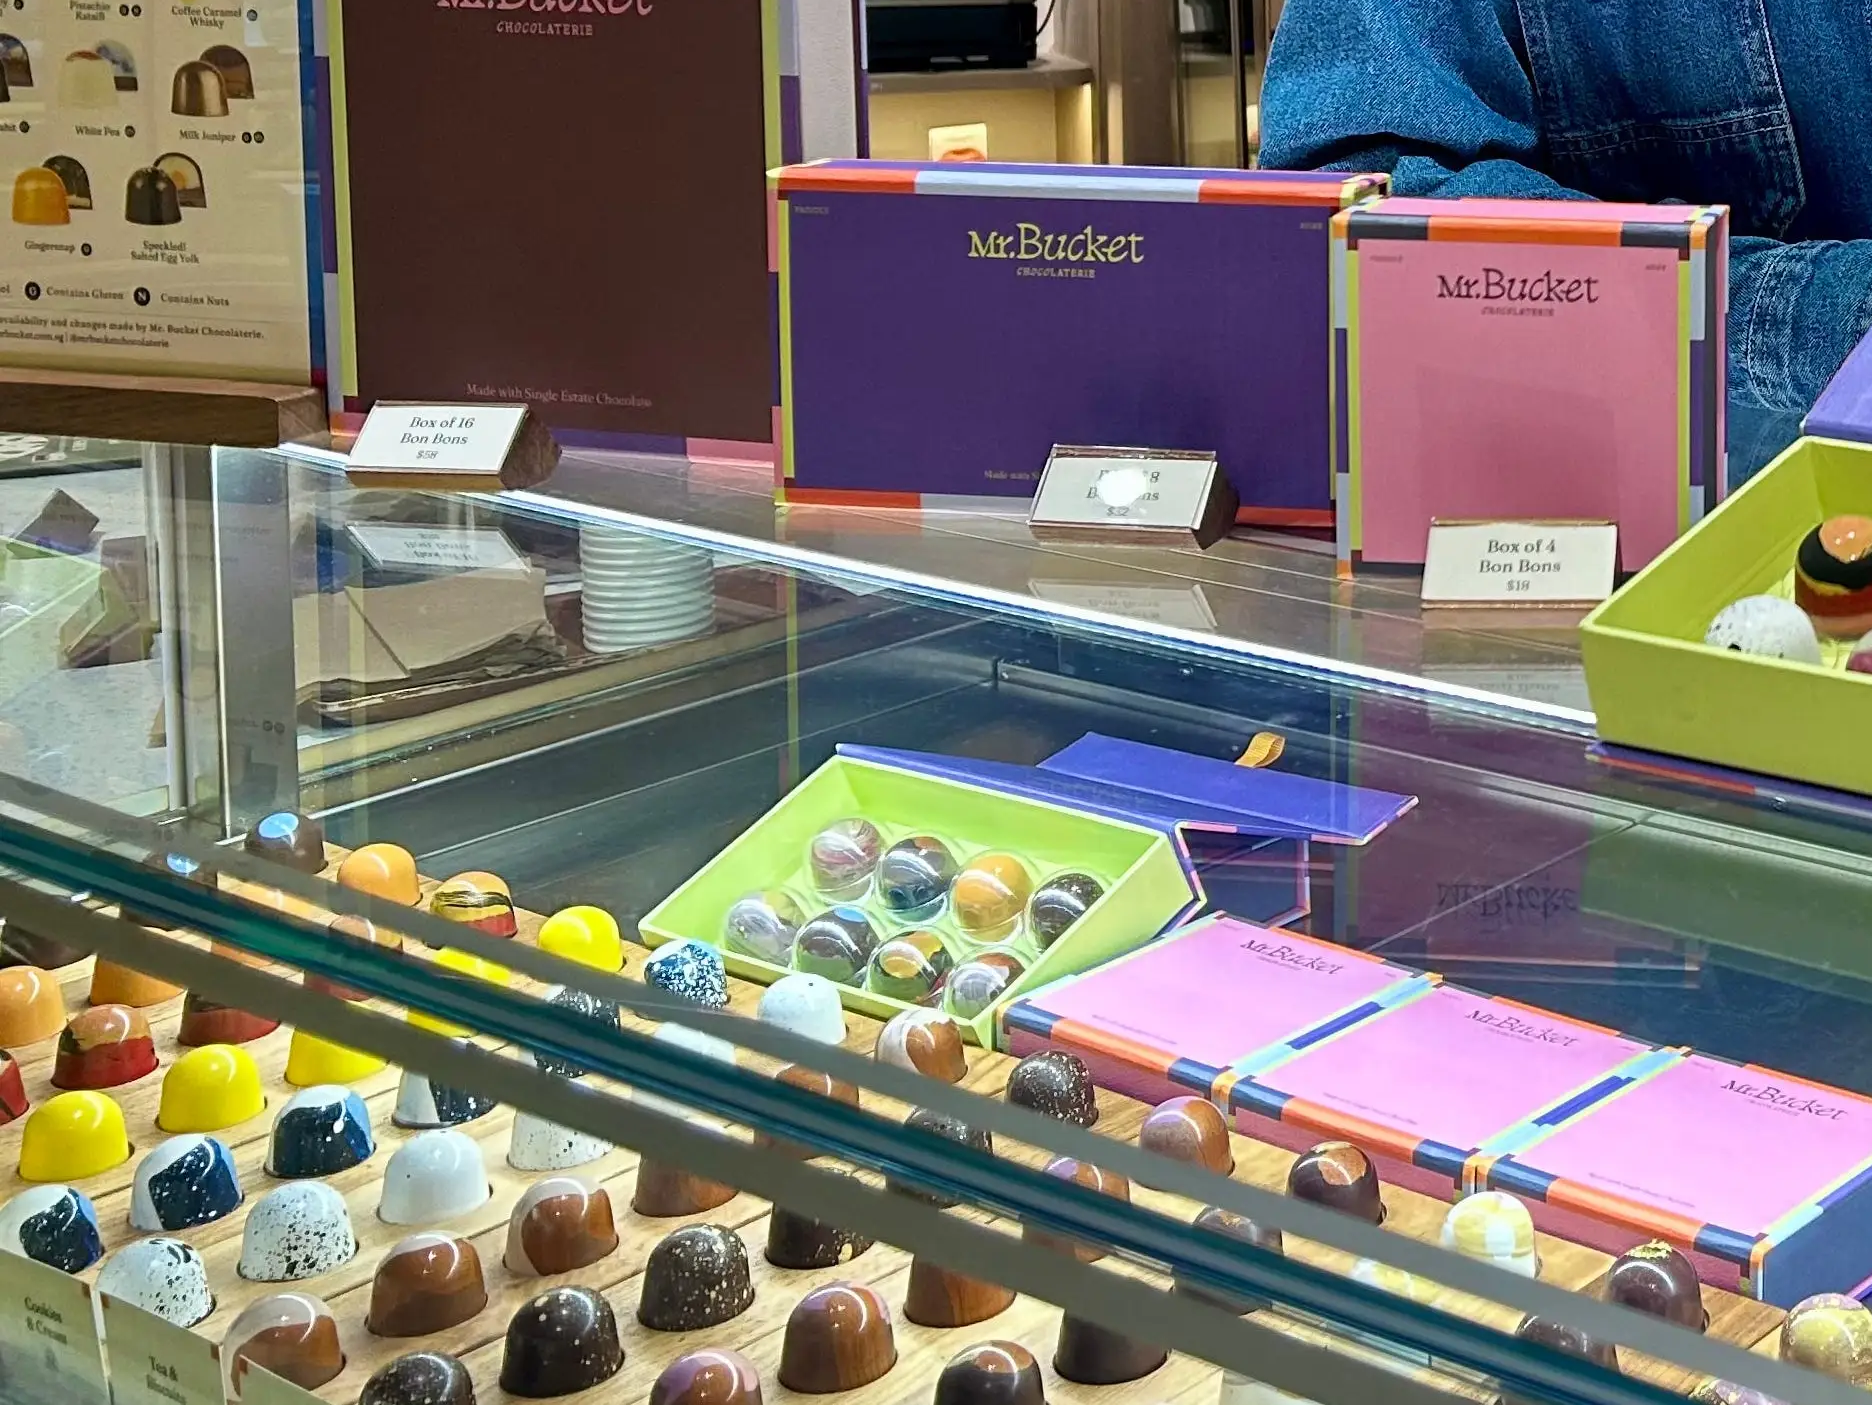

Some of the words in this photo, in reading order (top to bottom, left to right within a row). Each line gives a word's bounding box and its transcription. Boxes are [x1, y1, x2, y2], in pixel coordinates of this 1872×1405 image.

[171, 5, 201, 16] Coffee
[202, 6, 242, 18] Caramel
[189, 16, 225, 30] Whisky
[496, 21, 594, 36] CHOCOLATERIE
[75, 124, 102, 136] White
[179, 129, 200, 141] Milk
[202, 130, 236, 145] Juniper
[180, 253, 200, 264] Yolk
[46, 286, 90, 299] Contains
[92, 288, 124, 301] Gluten
[160, 292, 205, 305] Contains
[206, 295, 230, 307] Nuts
[51, 318, 67, 328] and
[135, 322, 146, 333] by
[167, 324, 199, 335] Bucket
[201, 326, 265, 339] Chocolaterie.
[466, 383, 496, 397] Made
[499, 386, 522, 399] with
[524, 387, 558, 403] Single
[560, 389, 595, 404] Estate
[596, 391, 653, 408] Chocolate
[409, 416, 437, 428] Box
[439, 416, 458, 428] of
[457, 417, 476, 429] 16
[400, 432, 429, 444] Bon
[432, 432, 469, 445] Bons
[1149, 471, 1161, 484] 8
[1487, 539, 1519, 554] Box
[1523, 538, 1541, 554] of
[1545, 538, 1556, 554] 4
[1479, 559, 1513, 574] Bon
[1518, 559, 1561, 574] Bons
[1505, 579, 1531, 592] $18
[24, 1296, 63, 1324] Cookies
[148, 1355, 169, 1378] Tea
